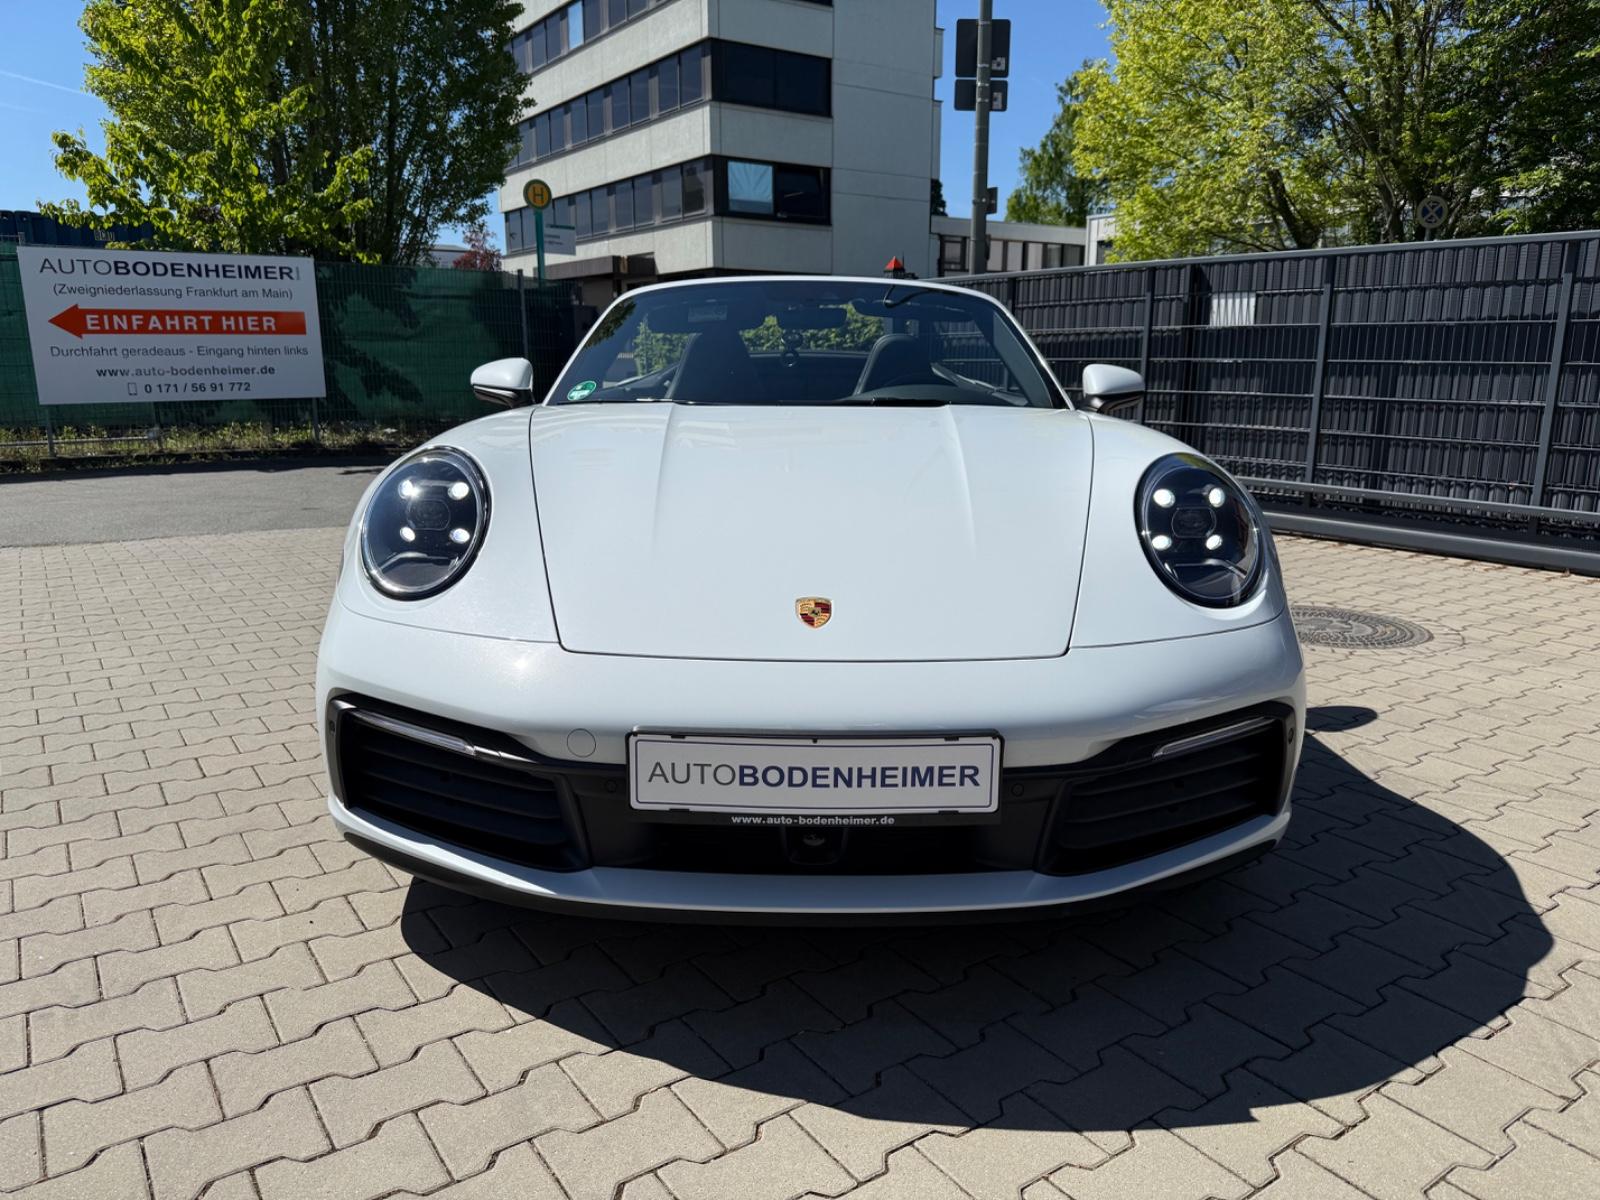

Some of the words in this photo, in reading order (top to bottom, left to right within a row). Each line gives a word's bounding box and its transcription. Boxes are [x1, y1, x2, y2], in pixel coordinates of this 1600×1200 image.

[532, 186, 545, 204] H
[39, 257, 294, 280] AUTOBODENHEIMER
[53, 283, 183, 299] (Zweigniederlassung
[186, 286, 238, 298] Frankfurt
[241, 288, 259, 298] am
[262, 288, 293, 300] Main)
[86, 314, 213, 331] EINFAHRT
[222, 316, 276, 331] HIER
[50, 346, 118, 357] Durchfahrt
[121, 346, 186, 359] geradeaus
[197, 346, 245, 359] Eingang
[247, 346, 282, 356] hinten
[284, 346, 308, 356] links
[96, 365, 276, 377] www.auto-bodenheimer.de
[144, 384, 152, 394] 0
[157, 383, 179, 393] 171
[191, 383, 207, 393] 56
[209, 382, 224, 392] 91
[229, 382, 251, 392] 772
[648, 761, 980, 788] AUTOBODENHEIMER
[731, 815, 895, 825] www.auto-bodenheimer.de
